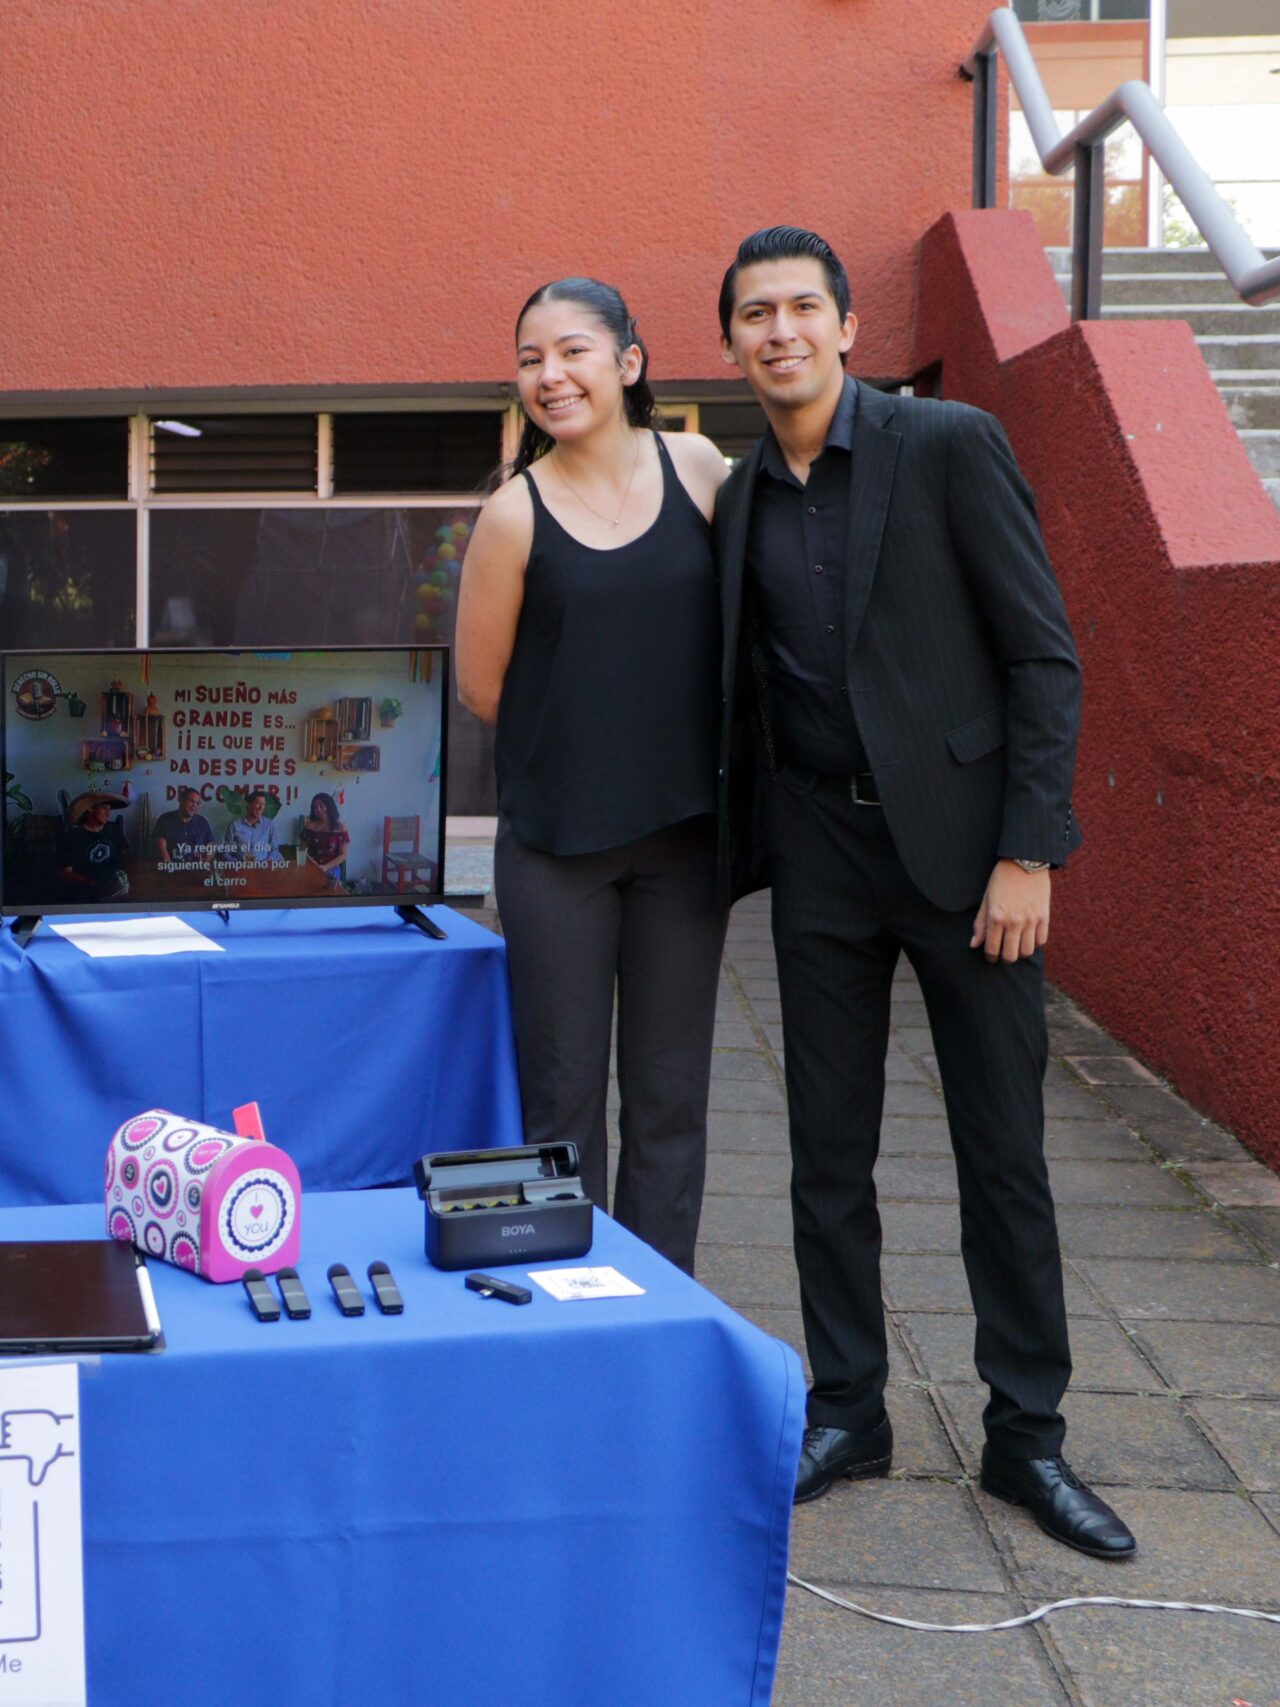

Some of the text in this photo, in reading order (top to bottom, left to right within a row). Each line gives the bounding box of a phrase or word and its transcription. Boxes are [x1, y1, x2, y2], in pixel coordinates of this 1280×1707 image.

[174, 681, 297, 704] MI SUEÑO MÁS
[173, 709, 252, 728] GRANDE
[197, 735, 215, 749] EL
[222, 735, 253, 749] QUE
[260, 735, 285, 751] ME
[170, 758, 190, 774] DA
[177, 842, 192, 853] Ya
[194, 842, 238, 855] regresé
[240, 841, 251, 853] el
[157, 860, 291, 873] siguiente temprano por
[204, 875, 247, 887] el carro
[243, 1221, 269, 1235] YOU
[501, 1224, 536, 1237] BOYA
